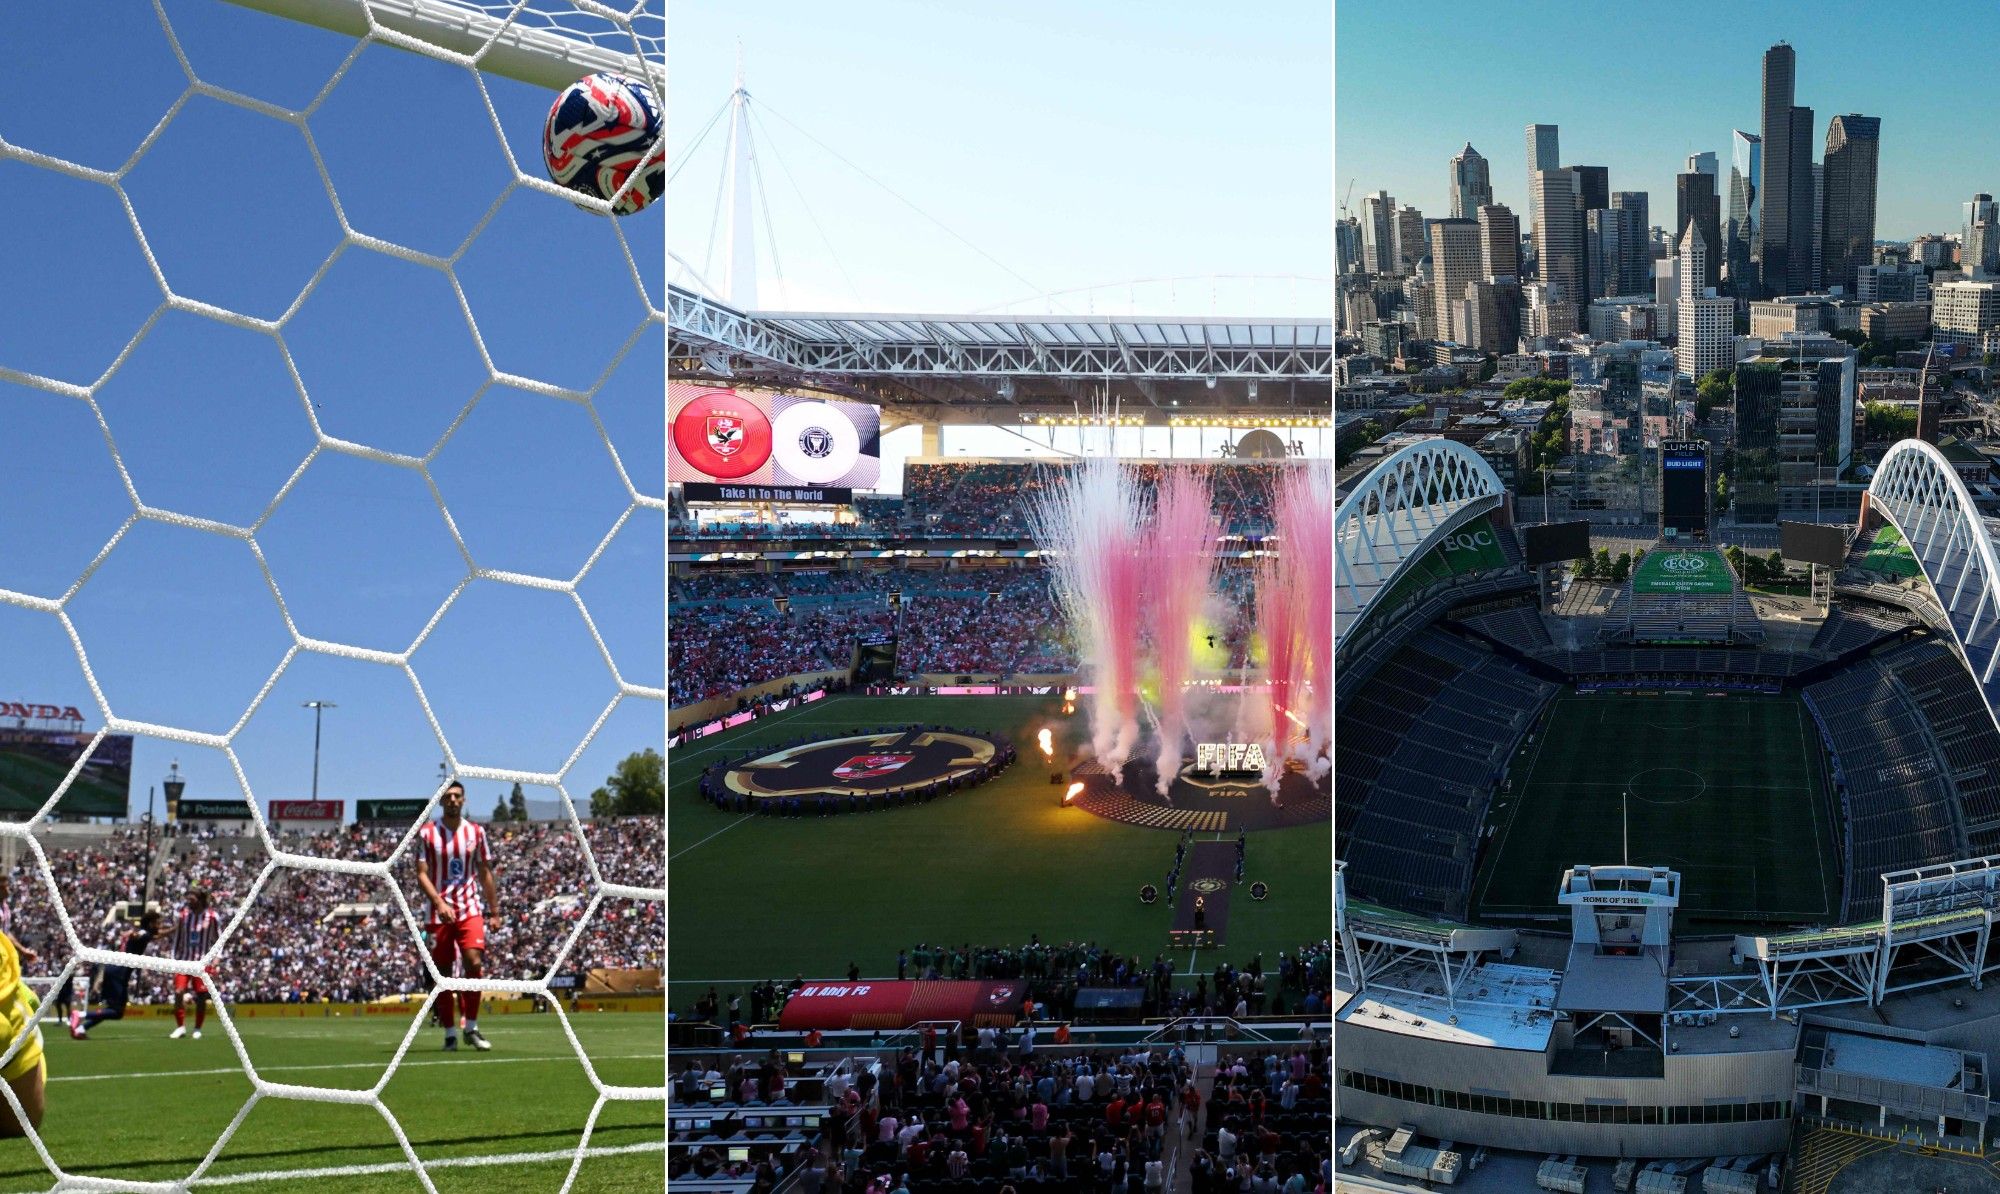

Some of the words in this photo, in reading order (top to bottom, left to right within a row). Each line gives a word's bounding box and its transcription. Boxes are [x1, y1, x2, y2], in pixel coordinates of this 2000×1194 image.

[720, 487, 746, 499] Take
[748, 488, 756, 499] It
[759, 488, 771, 499] To
[773, 489, 792, 500] The
[795, 489, 823, 501] World
[1443, 530, 1492, 552] EQC
[1663, 558, 1705, 571] EQC
[1197, 743, 1267, 771] FIFA
[1582, 896, 1608, 904] HOME
[800, 986, 819, 997] Al
[817, 986, 852, 998] Ahly
[851, 985, 872, 996] FC
